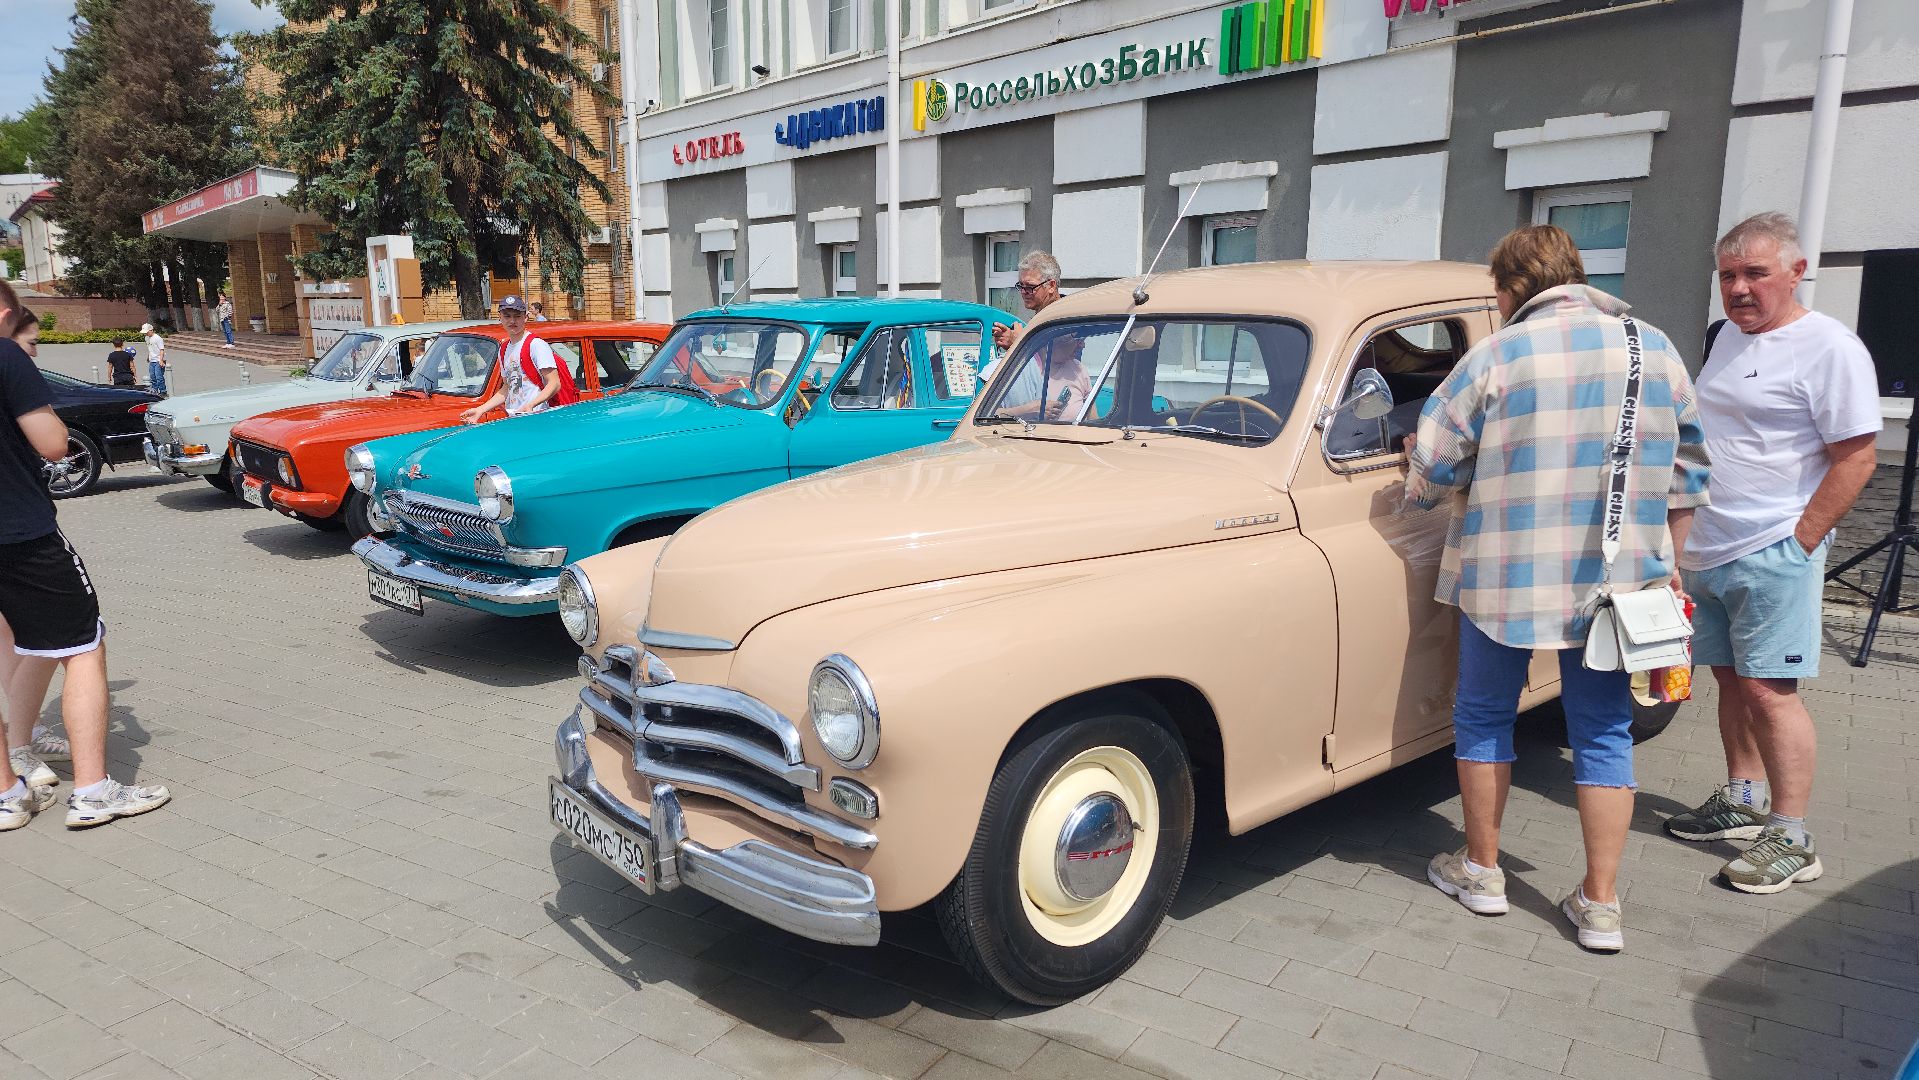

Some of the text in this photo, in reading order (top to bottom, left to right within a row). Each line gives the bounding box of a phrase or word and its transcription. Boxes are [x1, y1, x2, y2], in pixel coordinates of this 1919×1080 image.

[955, 37, 1209, 113] РоссельхозБанк
[685, 131, 744, 163] ОТЕЛЬ
[787, 96, 885, 149] АДВОКАТЫ
[1606, 493, 1624, 542] GUESS
